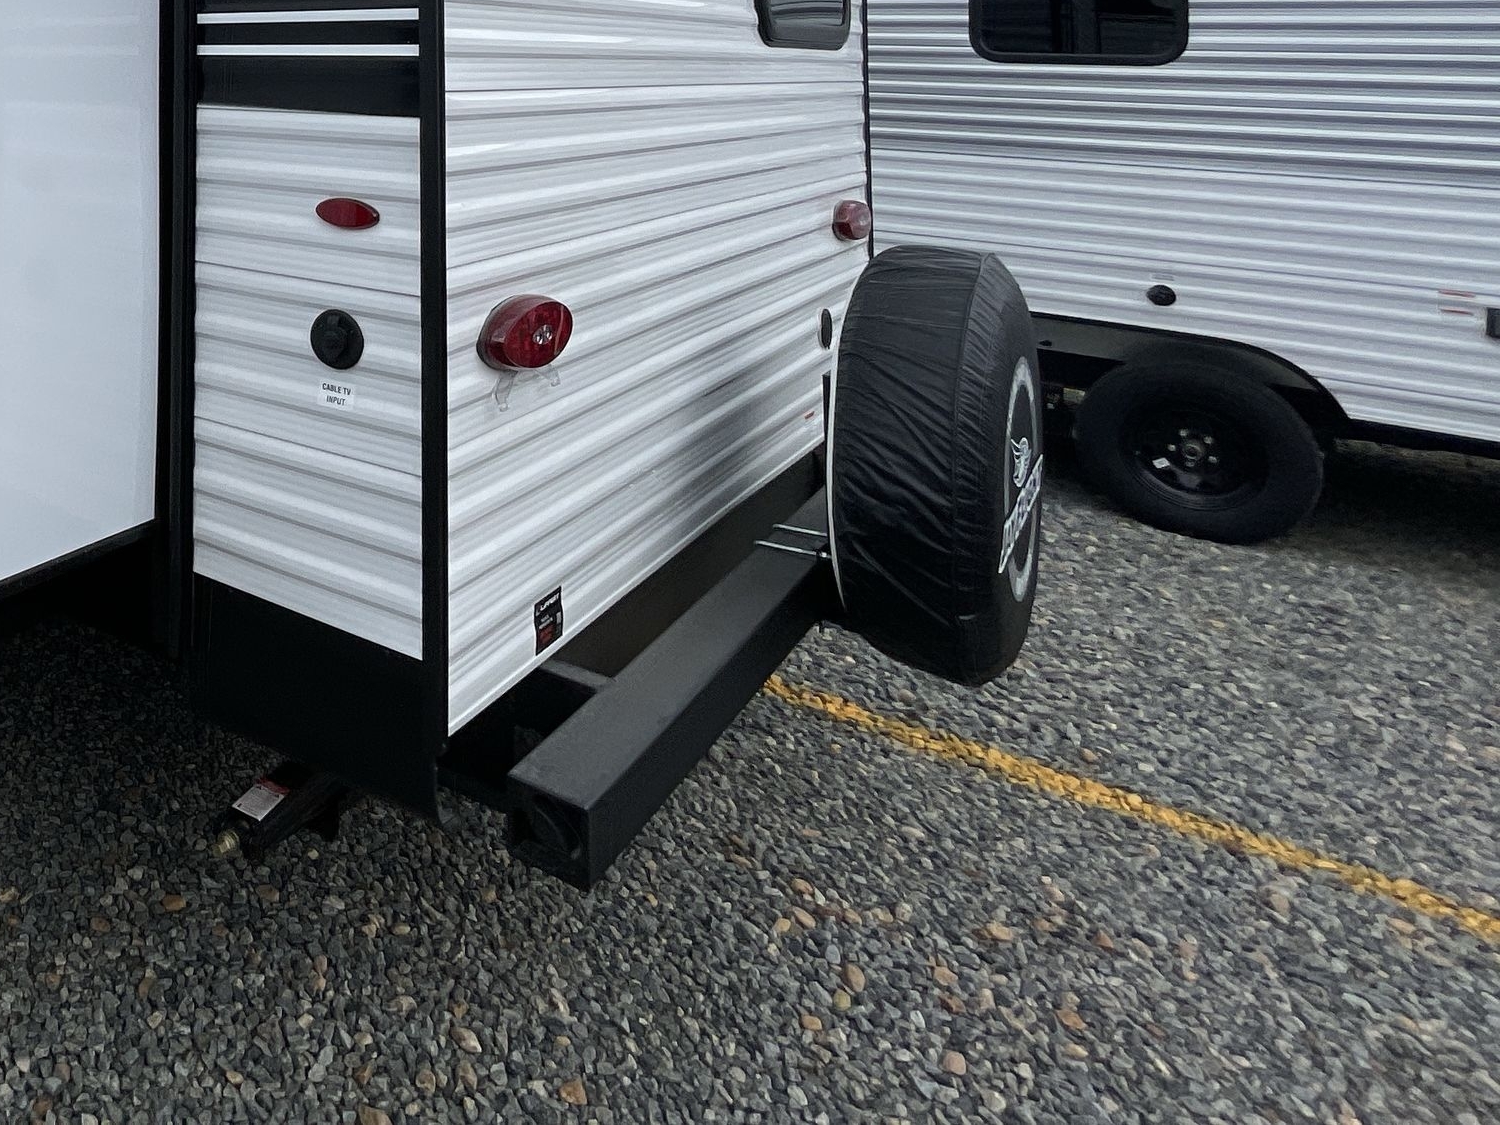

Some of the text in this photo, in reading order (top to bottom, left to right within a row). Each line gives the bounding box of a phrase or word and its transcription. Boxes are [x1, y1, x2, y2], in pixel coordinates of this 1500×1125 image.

[322, 382, 352, 396] CABLE TV
[326, 395, 346, 406] INPUT
